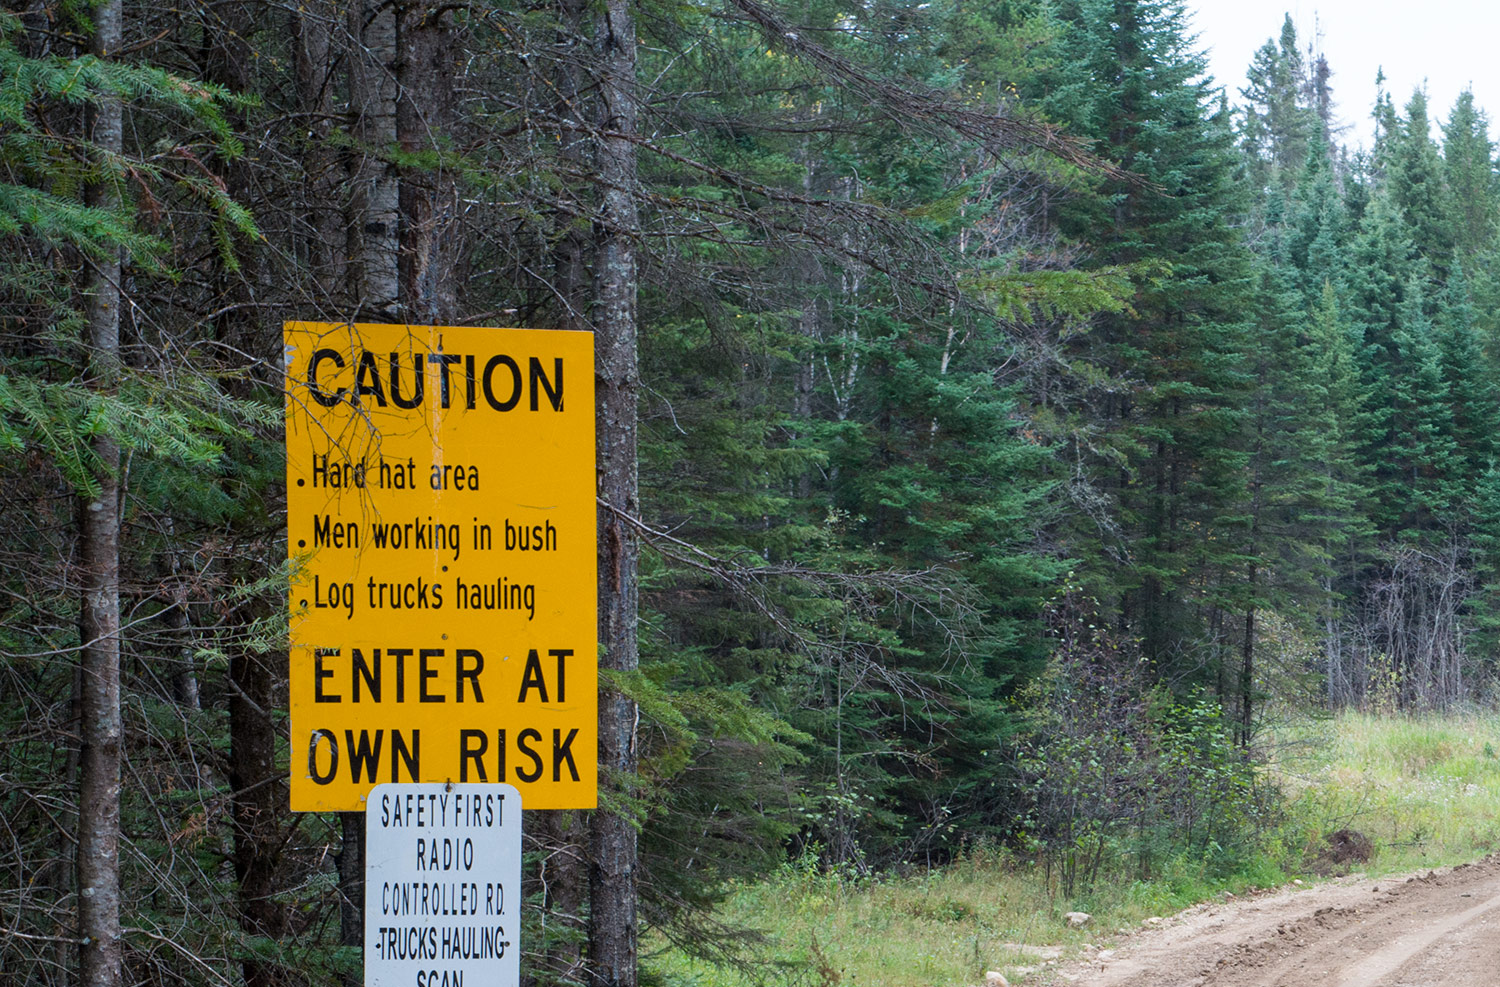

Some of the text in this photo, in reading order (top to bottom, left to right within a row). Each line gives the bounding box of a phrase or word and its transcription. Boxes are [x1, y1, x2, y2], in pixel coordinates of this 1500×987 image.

[307, 348, 565, 413] CAUTION
[312, 454, 480, 491] Hard hat area
[313, 515, 558, 561] Men working in bush
[314, 575, 536, 621] Log trucks hauling
[314, 648, 574, 704] ENTER AT
[308, 727, 581, 786] OWN RISK
[381, 794, 505, 828] SAFETY FIRST
[416, 837, 474, 871] RADIO
[382, 882, 506, 916] CONTROLLED RD.
[379, 925, 505, 960] TRUCKS HAULING
